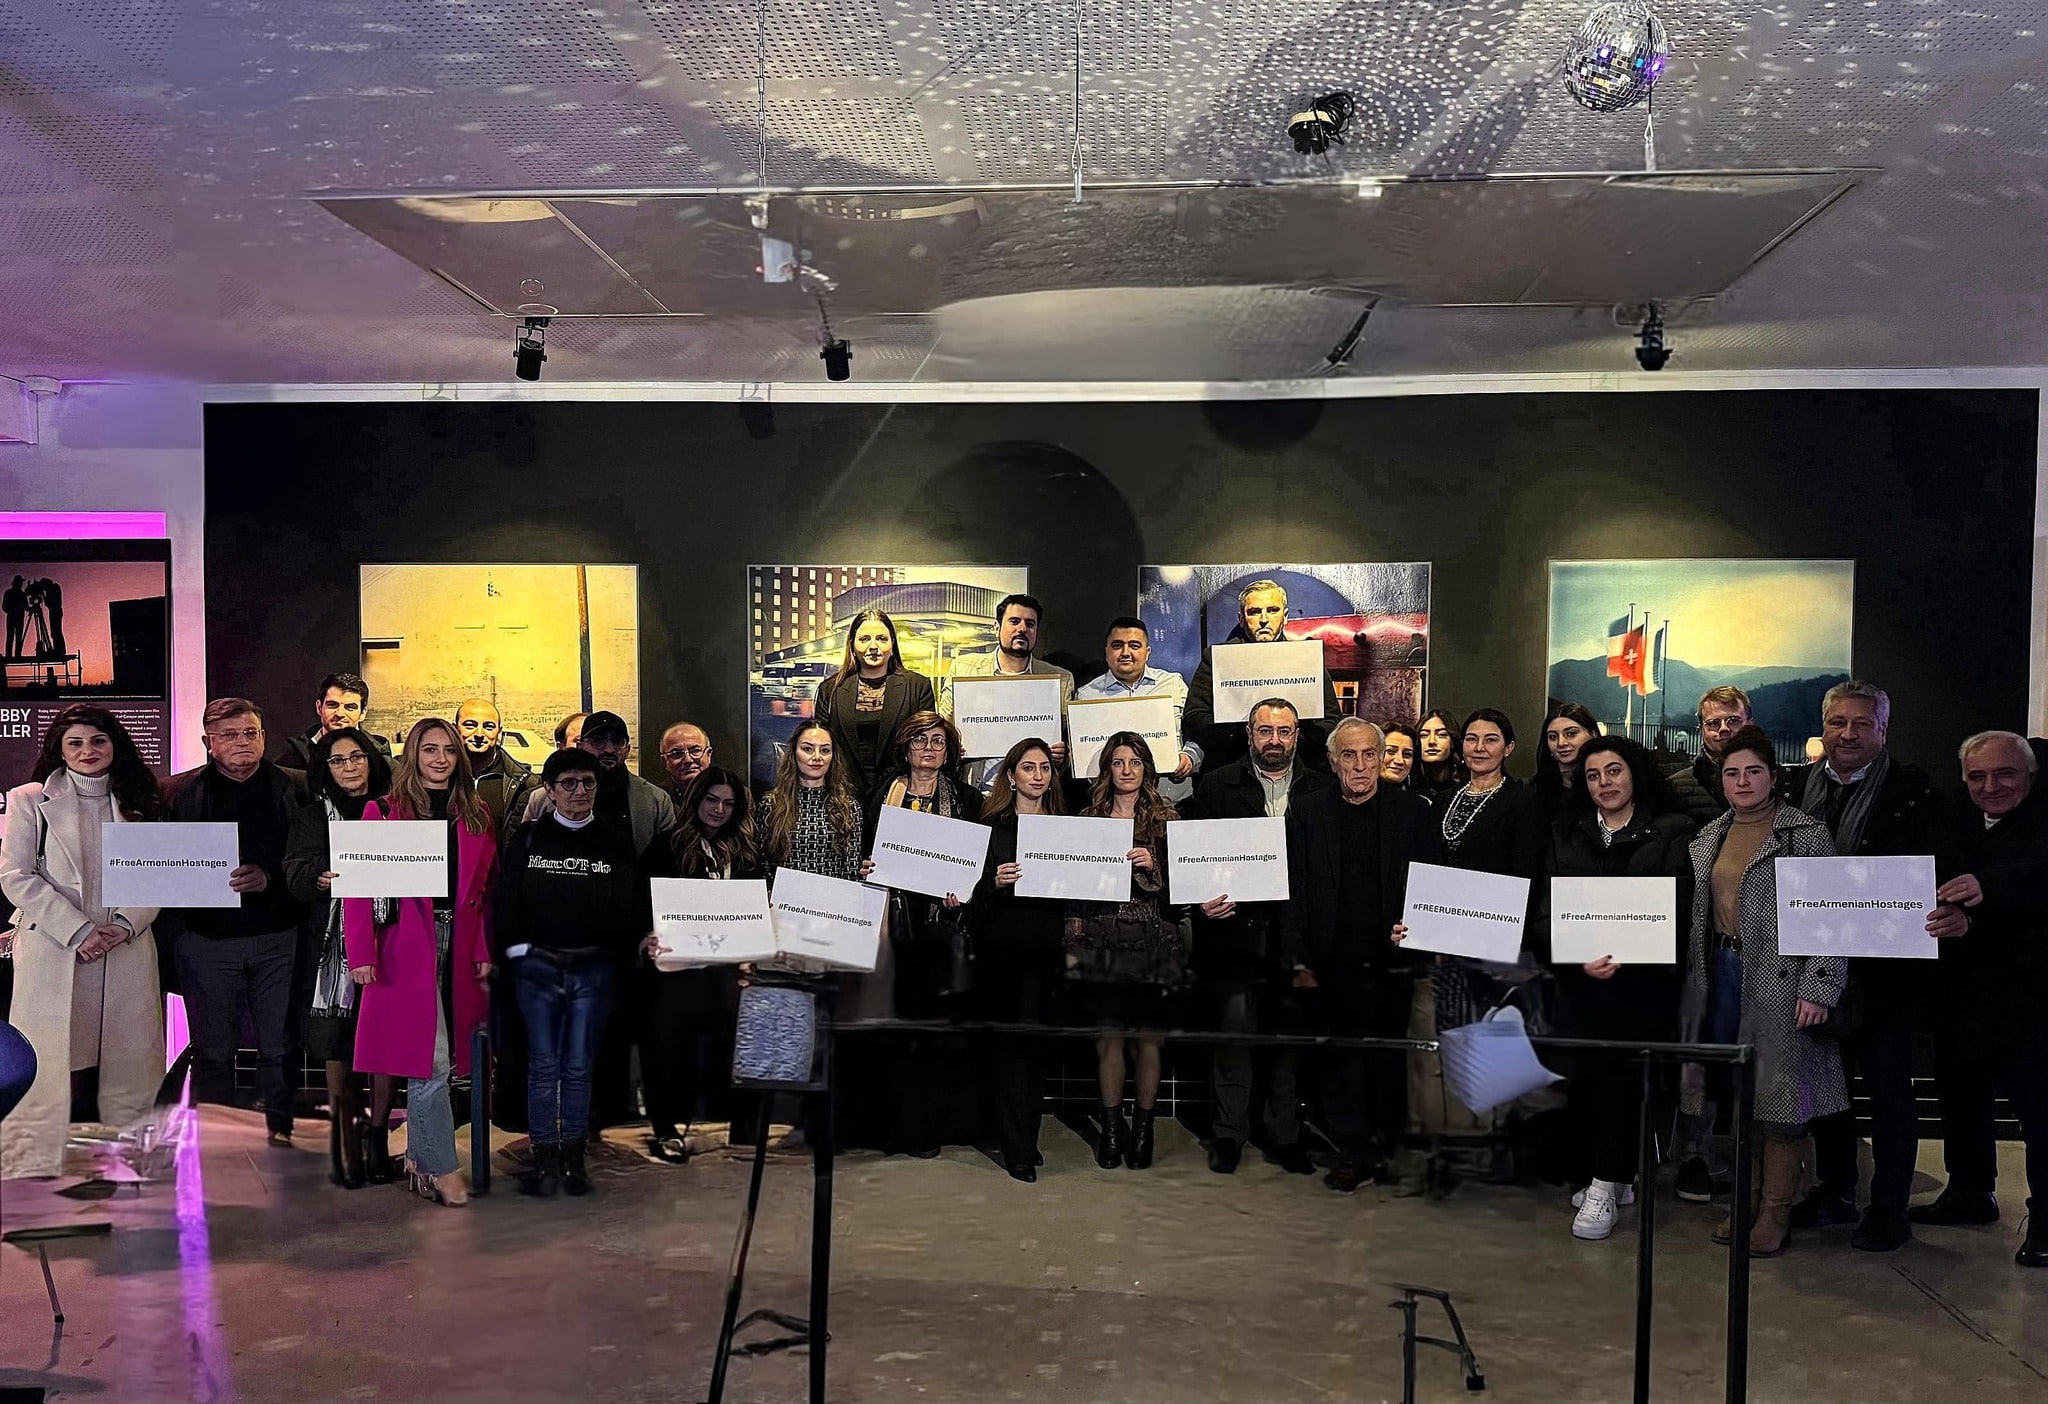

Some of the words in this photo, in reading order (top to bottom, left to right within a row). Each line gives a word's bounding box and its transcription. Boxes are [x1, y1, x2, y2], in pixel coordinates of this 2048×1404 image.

[1220, 676, 1317, 688] #FREERUBENVARDANYAN
[961, 714, 1054, 724] #FREERUBENVARDANYAN
[339, 852, 444, 863] #FREERUBENVARDANYAN
[881, 841, 977, 868] #FREERUBENVARDANYAN
[1024, 851, 1125, 865] #FREERUBENVARDANYAN
[1177, 853, 1280, 865] #FreeArmenianHostages
[109, 858, 228, 870] #FreeArmenianHostages
[1789, 899, 1924, 912] #FreeArmenianHostages
[661, 912, 763, 922] #FREERUBENVARDANYAN
[778, 903, 872, 927] #FreeArmenianHostages
[1412, 903, 1520, 924] #FREERUBENVARDANYAN
[1560, 912, 1667, 924] #FreeArmenianHostages
